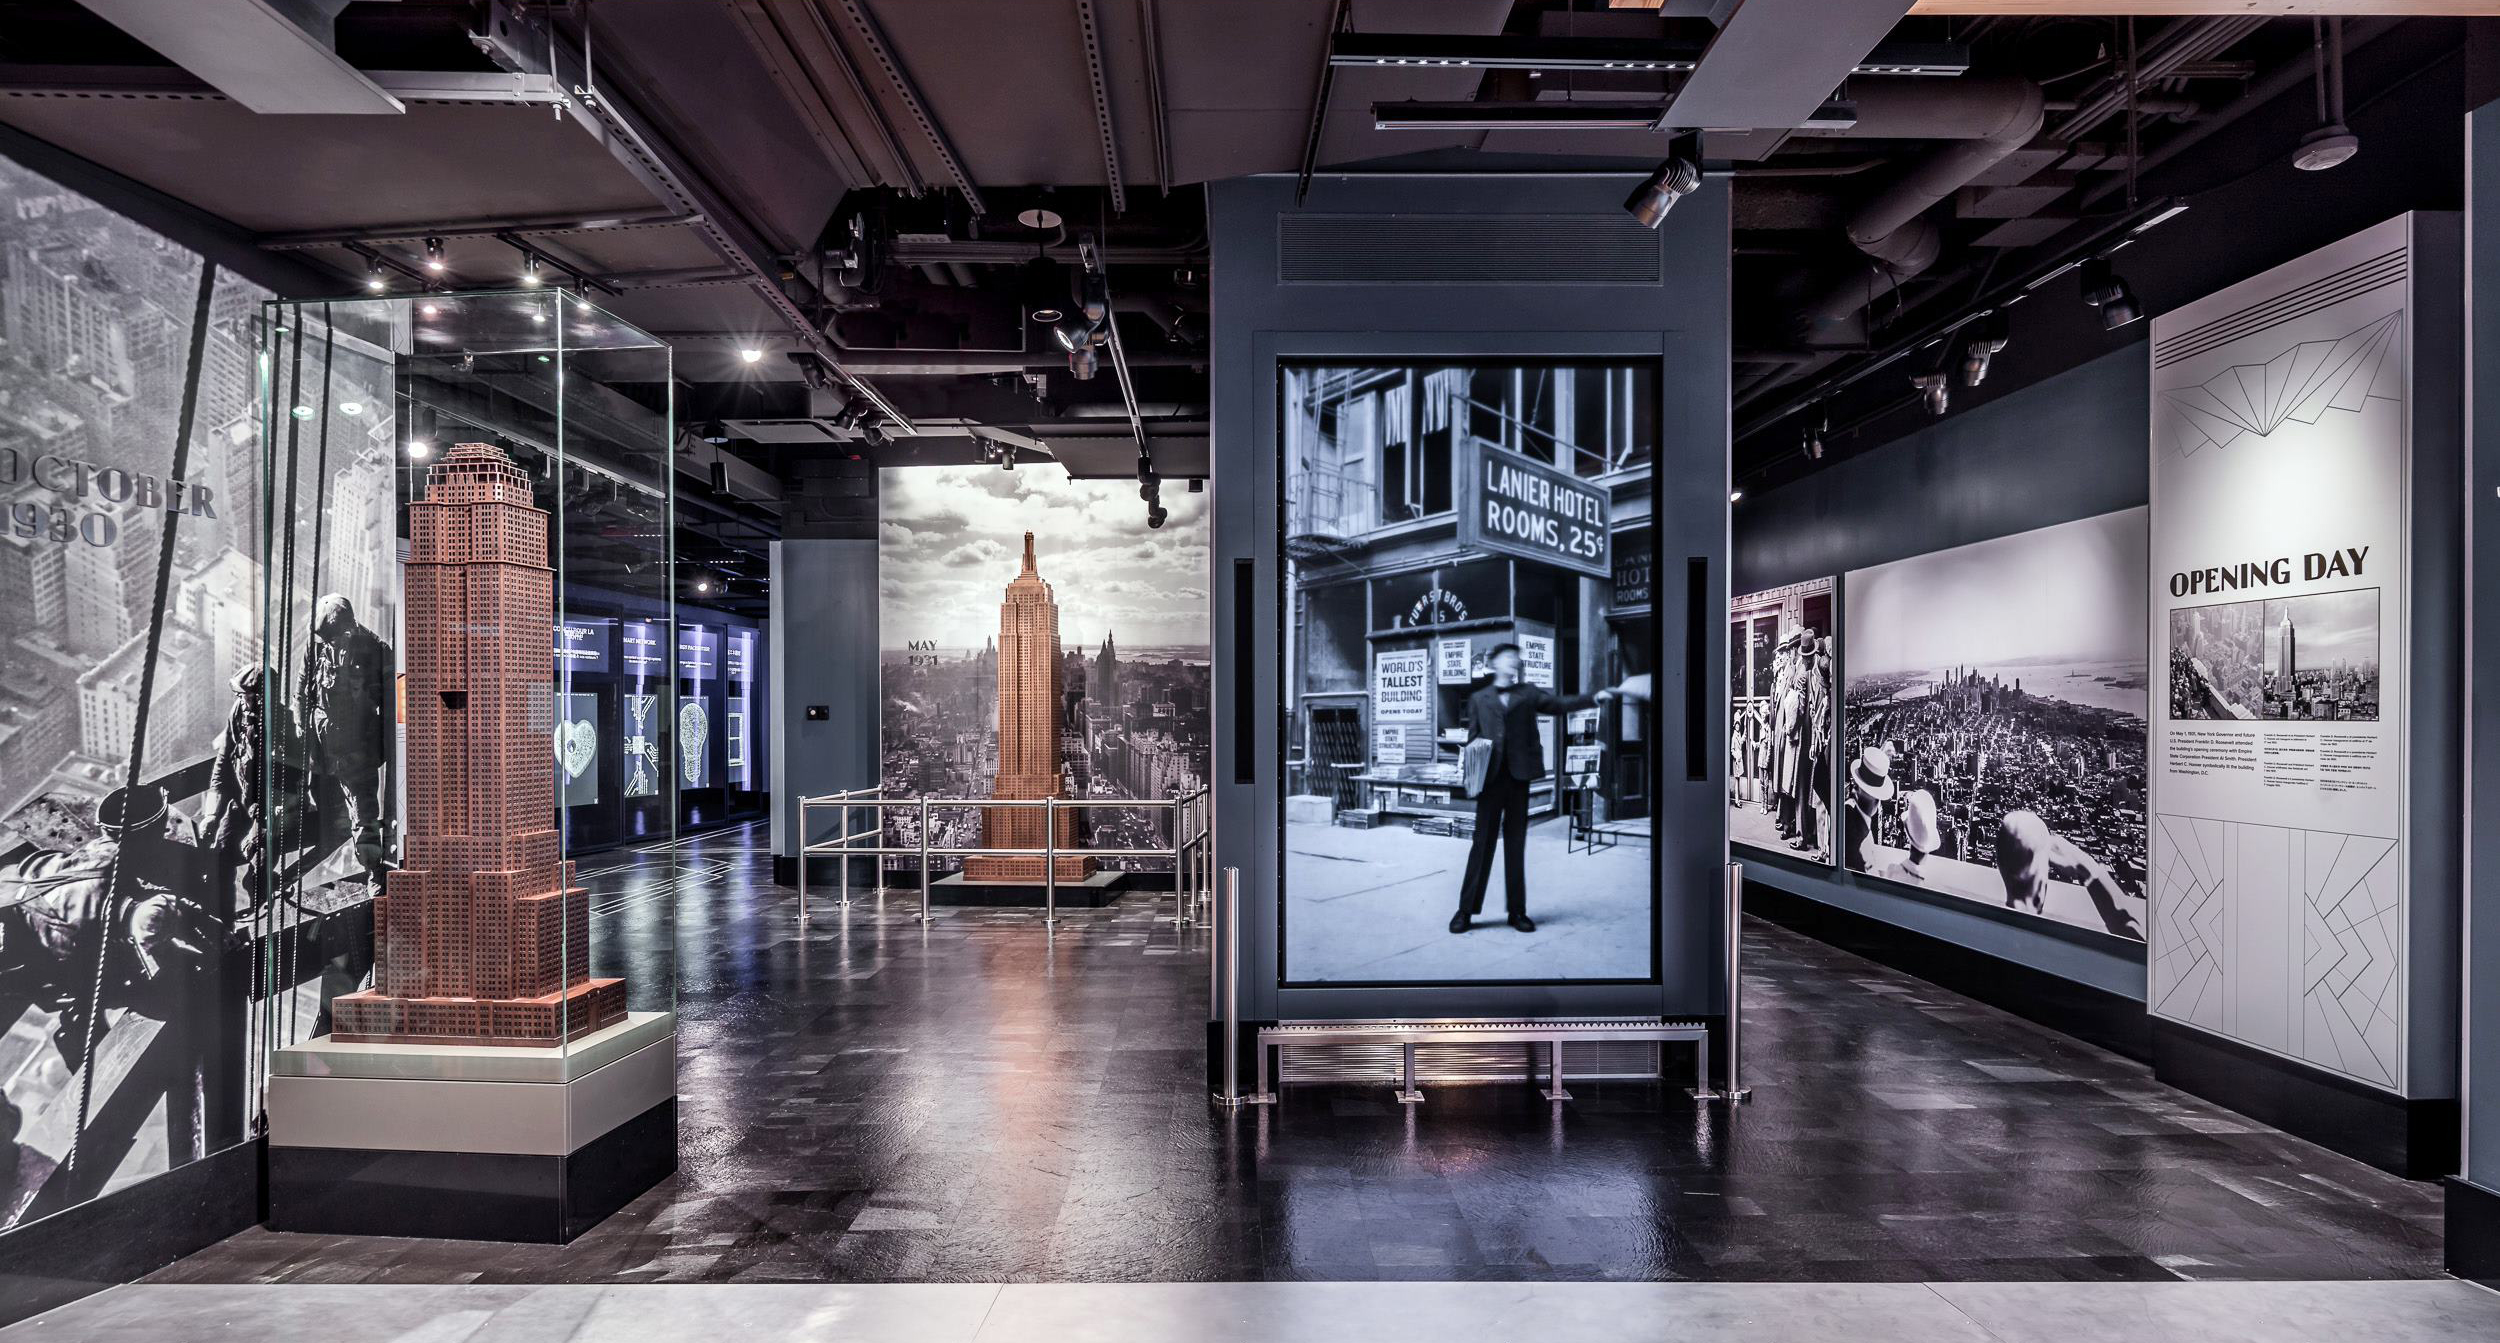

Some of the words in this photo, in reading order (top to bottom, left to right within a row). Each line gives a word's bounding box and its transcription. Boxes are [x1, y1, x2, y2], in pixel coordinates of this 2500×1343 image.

[0, 448, 217, 519] OCTOBER
[1488, 460, 1550, 510] LANIER
[1554, 484, 1603, 527] HOTEL
[0, 501, 118, 547] 1930
[1488, 500, 1565, 552] ROOMS,
[1570, 525, 1604, 557] 25¢
[1616, 567, 1651, 587] HOT
[2169, 557, 2291, 598] OPENING
[2304, 545, 2370, 581] DAY
[1616, 587, 1649, 603] ROOMS
[908, 639, 938, 651] MAY
[1526, 641, 1546, 651] EMPIRE
[908, 654, 938, 666] 1931
[1445, 650, 1464, 659] EMPIRE
[1528, 651, 1545, 661] STATE
[1381, 660, 1424, 674] WORLD'S
[1447, 660, 1462, 668] STATE
[1381, 675, 1423, 688] TALLEST
[1381, 690, 1423, 703] BUILDING
